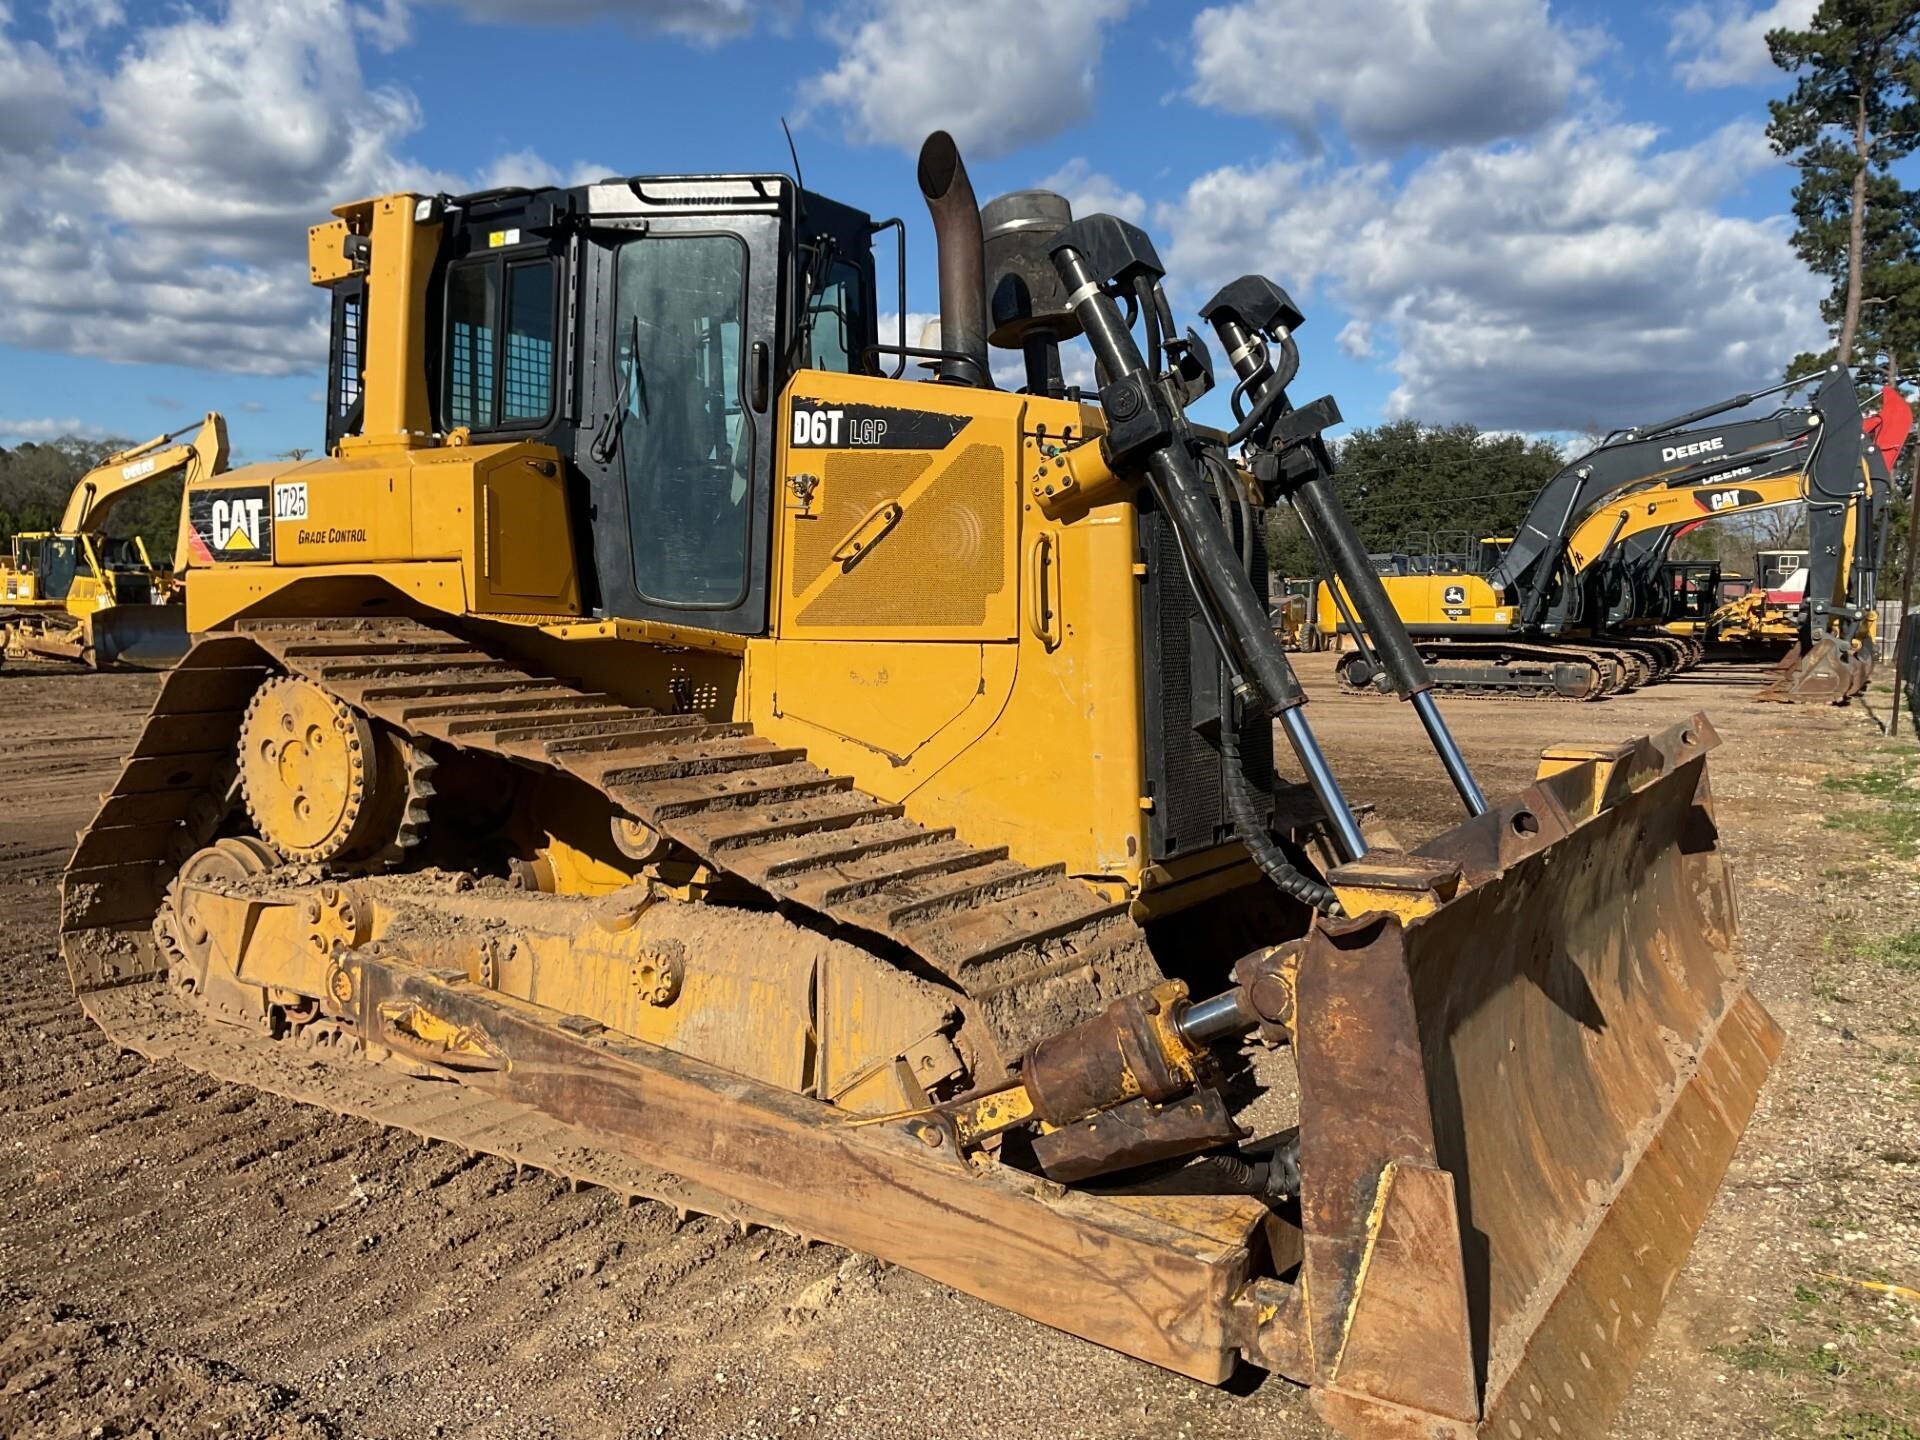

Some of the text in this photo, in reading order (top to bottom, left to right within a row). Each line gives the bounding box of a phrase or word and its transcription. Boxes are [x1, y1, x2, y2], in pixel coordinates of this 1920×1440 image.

[793, 410, 888, 445] D6T LGP
[1662, 437, 1724, 462] DEERE
[277, 486, 306, 518] 1725
[1711, 490, 1740, 510] CAT
[212, 498, 263, 550] CAT
[298, 527, 367, 544] GRADE CONTROL
